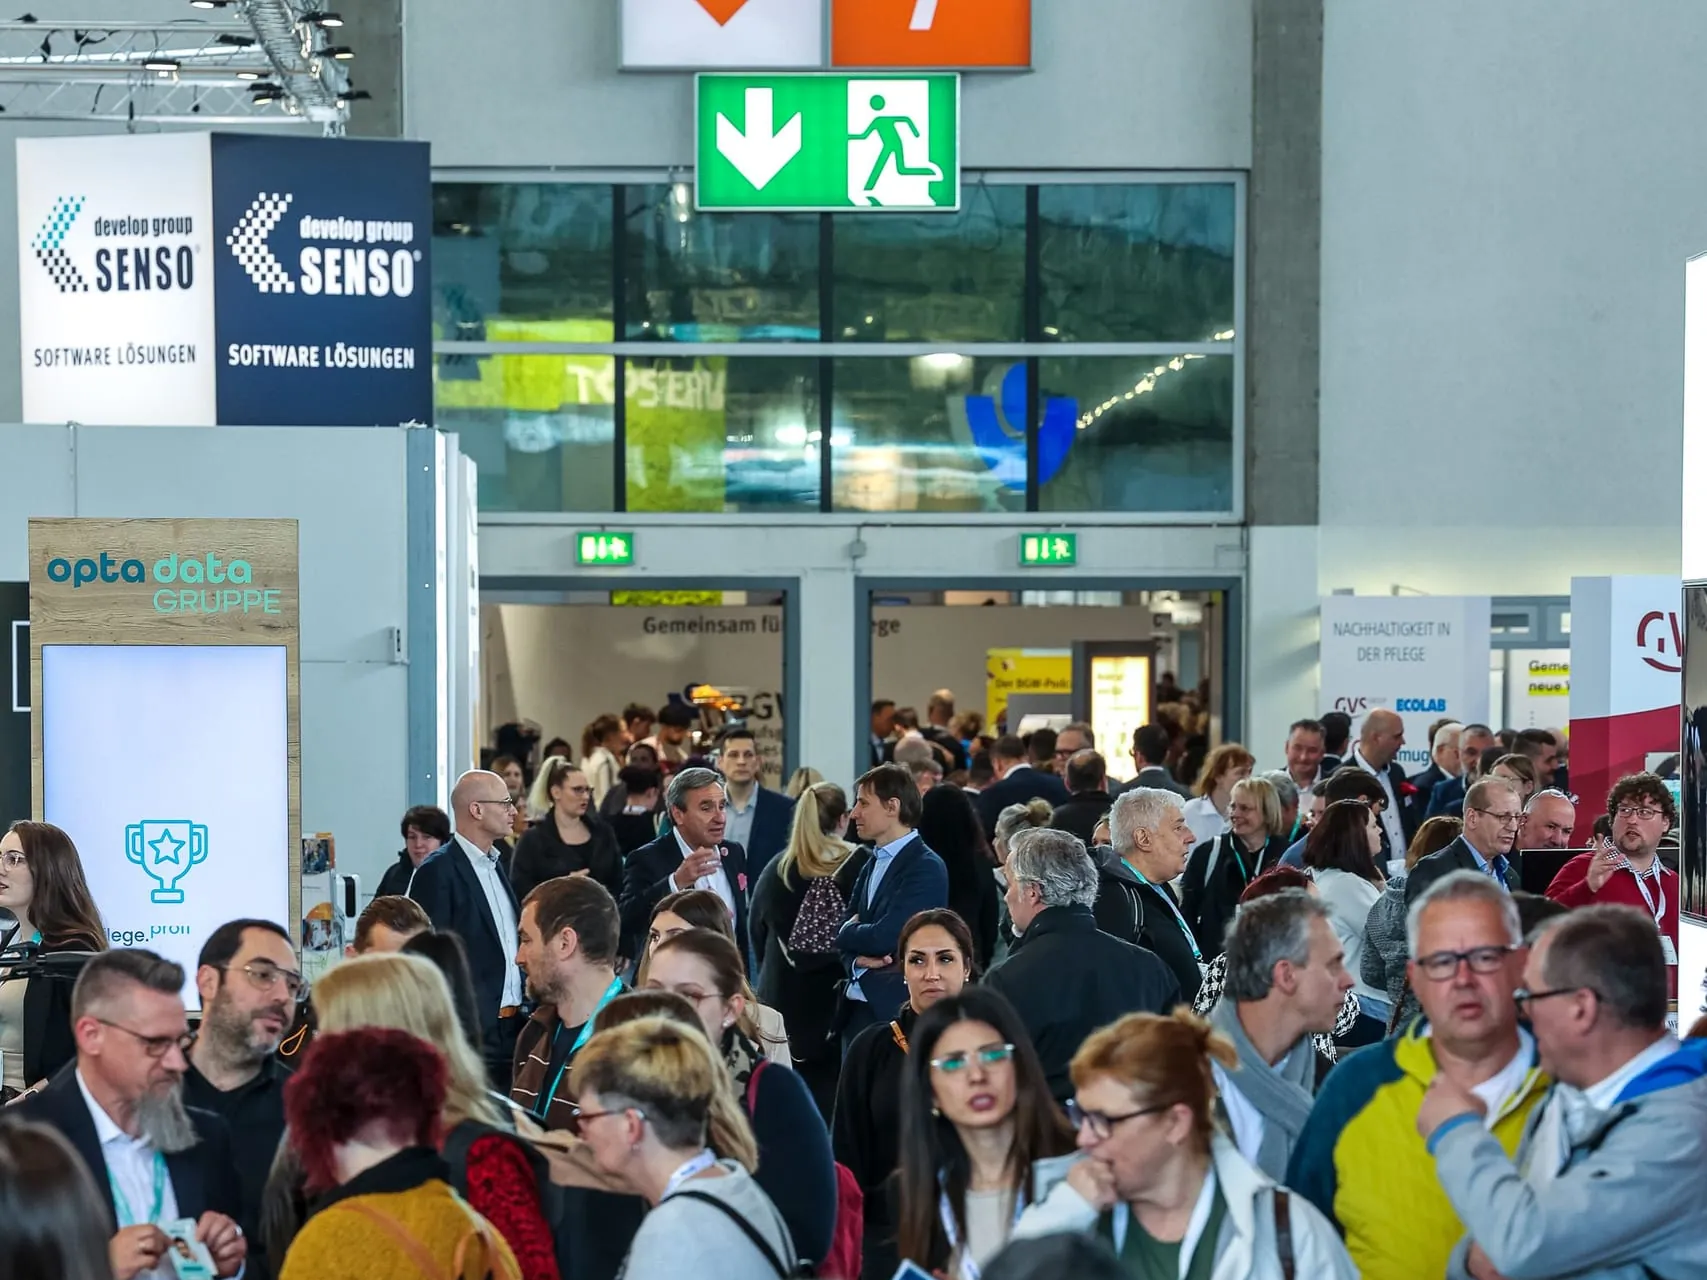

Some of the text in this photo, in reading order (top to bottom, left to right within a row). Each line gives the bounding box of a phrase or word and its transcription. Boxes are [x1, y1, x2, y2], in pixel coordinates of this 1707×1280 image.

[94, 215, 193, 237] develop group
[300, 215, 414, 244] develop group
[95, 245, 193, 292] SENSO
[34, 342, 196, 367] SOFTWARE LÖSUNGEN
[228, 342, 415, 369] SOFTWARE LÖSUNGEN
[47, 552, 252, 588] opta data
[153, 589, 281, 614] GRUPPE
[643, 616, 756, 635] Gemeinsam
[1333, 622, 1450, 636] NACHHALTIGKEIT IN
[1357, 647, 1426, 661] DER PFLEGE
[1396, 698, 1446, 712] ECOLAB
[105, 928, 149, 946] lege.
